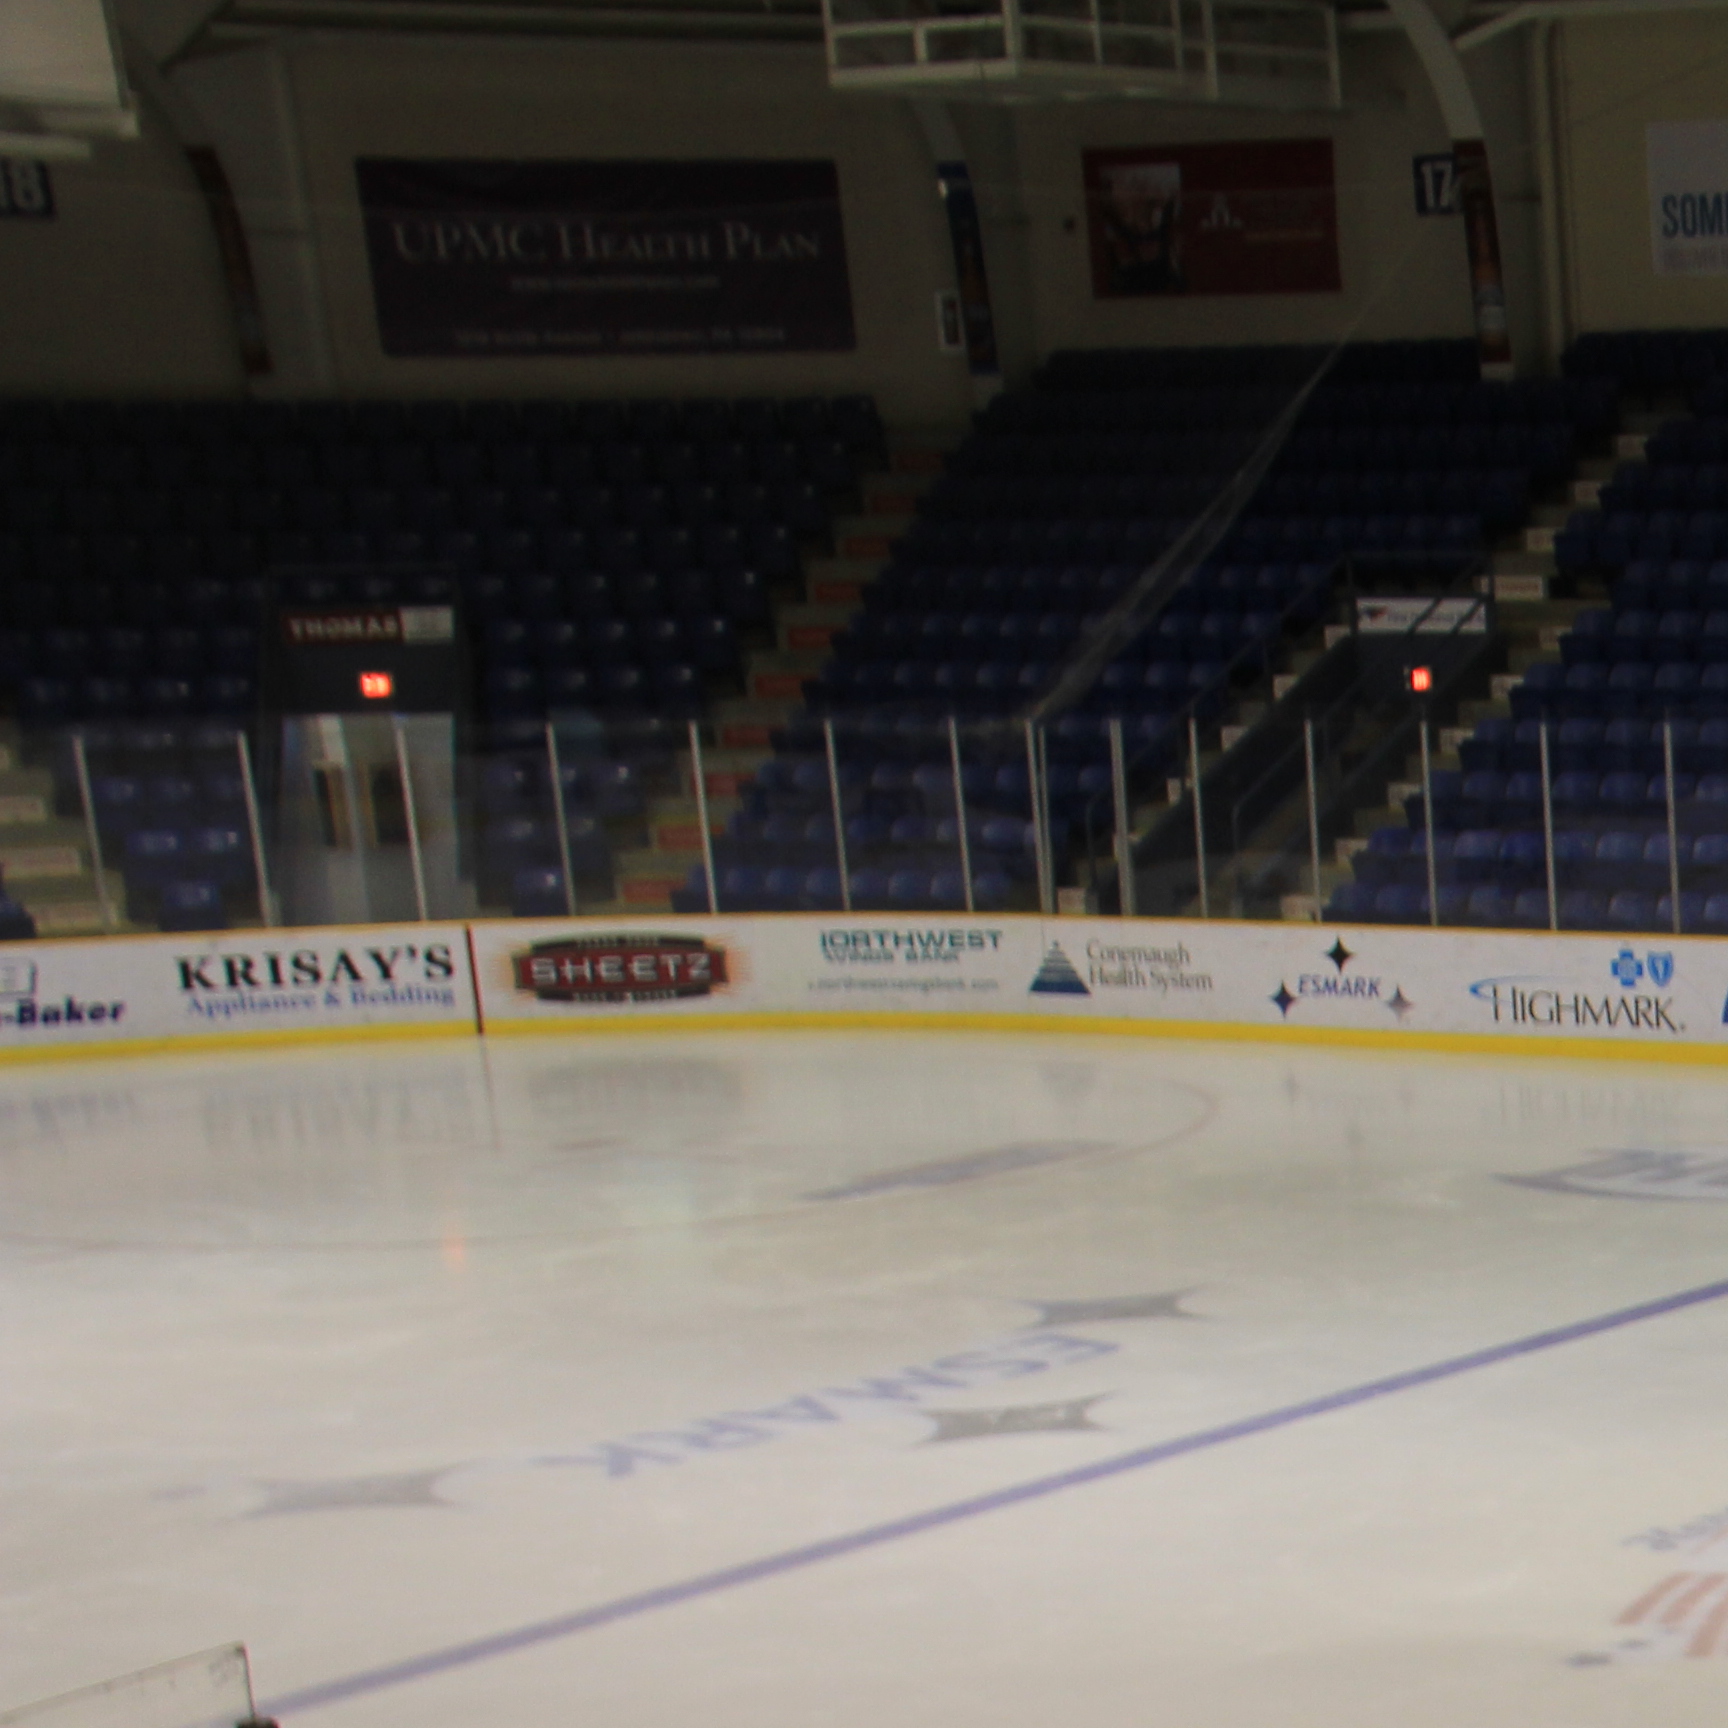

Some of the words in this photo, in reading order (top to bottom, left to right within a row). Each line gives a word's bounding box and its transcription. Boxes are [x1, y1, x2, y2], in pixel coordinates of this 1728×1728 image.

[1419, 161, 1458, 211] 17
[393, 221, 547, 263] UPMC
[176, 941, 455, 991] KRISAY'S
[530, 952, 712, 985] SHEETZ
[1085, 938, 1190, 967] Conemaugh
[1088, 967, 1146, 989] Health
[1150, 970, 1213, 993] System
[1298, 974, 1382, 999] ESMARK
[185, 988, 317, 1020] Appliance
[322, 986, 342, 1010] &
[346, 982, 456, 1012] Bedding
[1490, 986, 1677, 1032] HIGHMARK
[536, 1334, 1120, 1482] ESMARK
